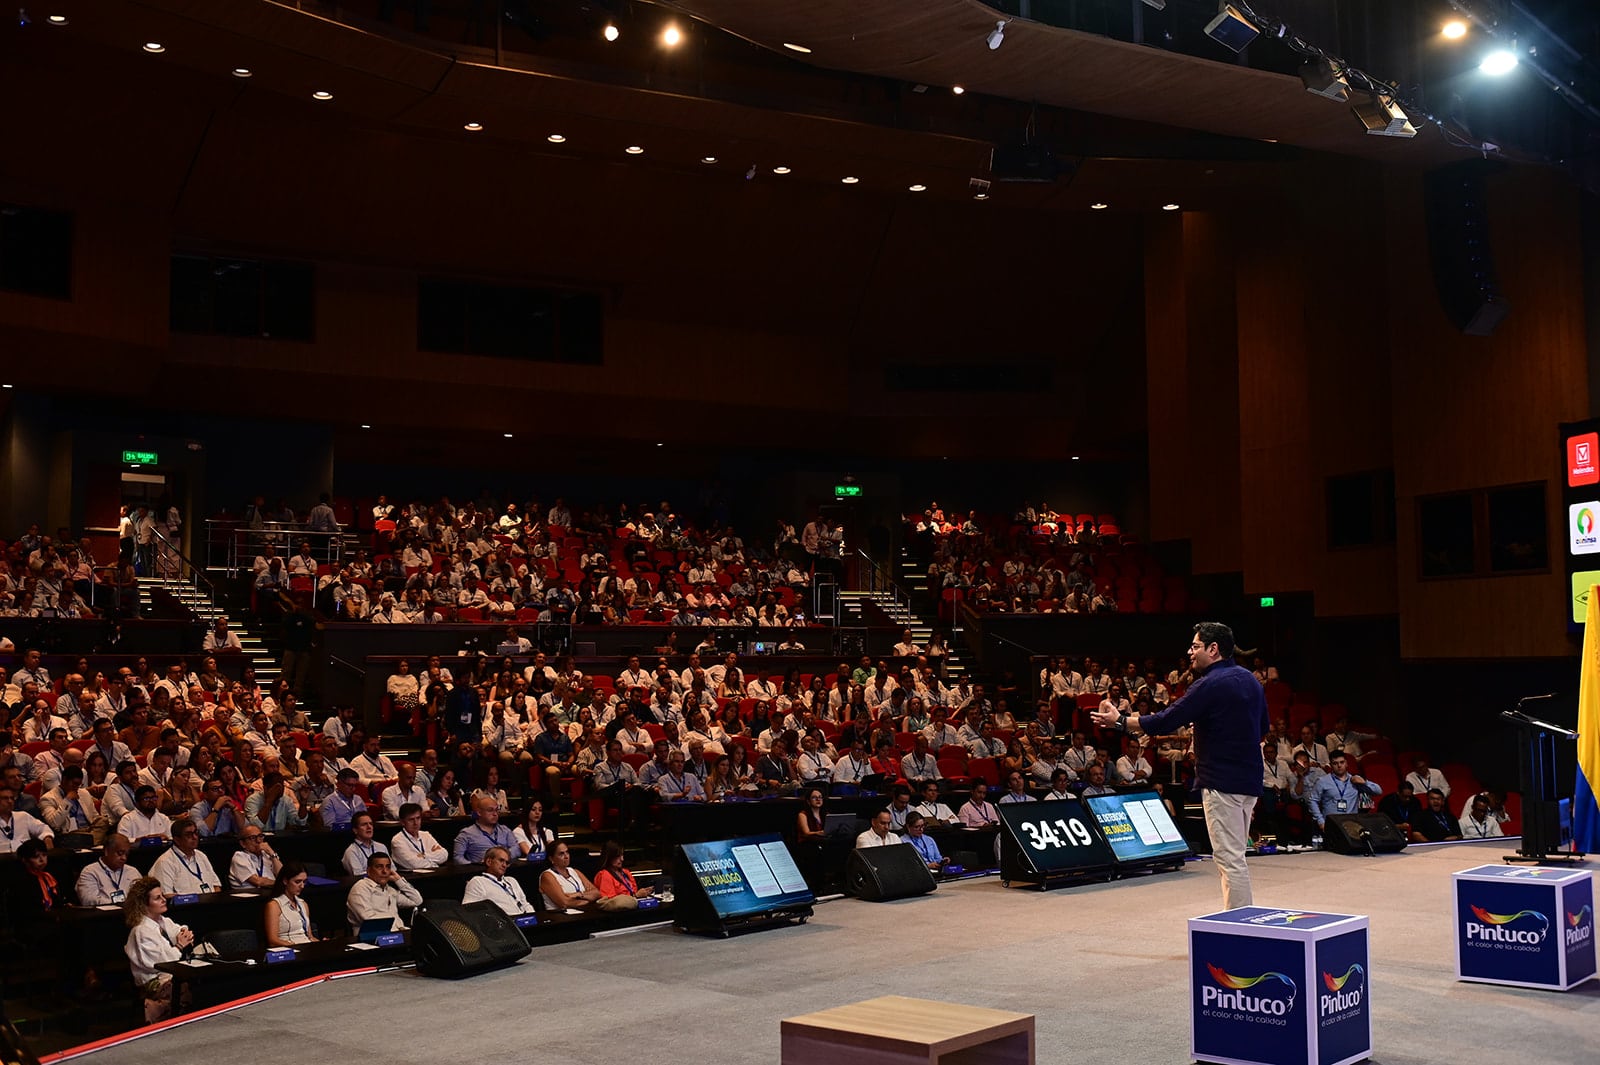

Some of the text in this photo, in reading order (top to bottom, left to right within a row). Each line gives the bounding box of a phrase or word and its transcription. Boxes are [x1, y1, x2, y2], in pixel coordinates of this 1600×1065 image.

[1021, 818, 1092, 850] 34:19
[694, 858, 735, 872] EL DETERIORO
[700, 876, 715, 887] DEL
[1466, 922, 1540, 944] Pintuco
[1566, 926, 1589, 945] Pintuco
[1202, 985, 1286, 1016] Pintuco
[1320, 990, 1360, 1016] Pintuco
[1212, 1010, 1232, 1018] color
[1233, 1012, 1244, 1021] de
[1245, 1013, 1254, 1022] la
[1255, 1014, 1287, 1026] calidad
